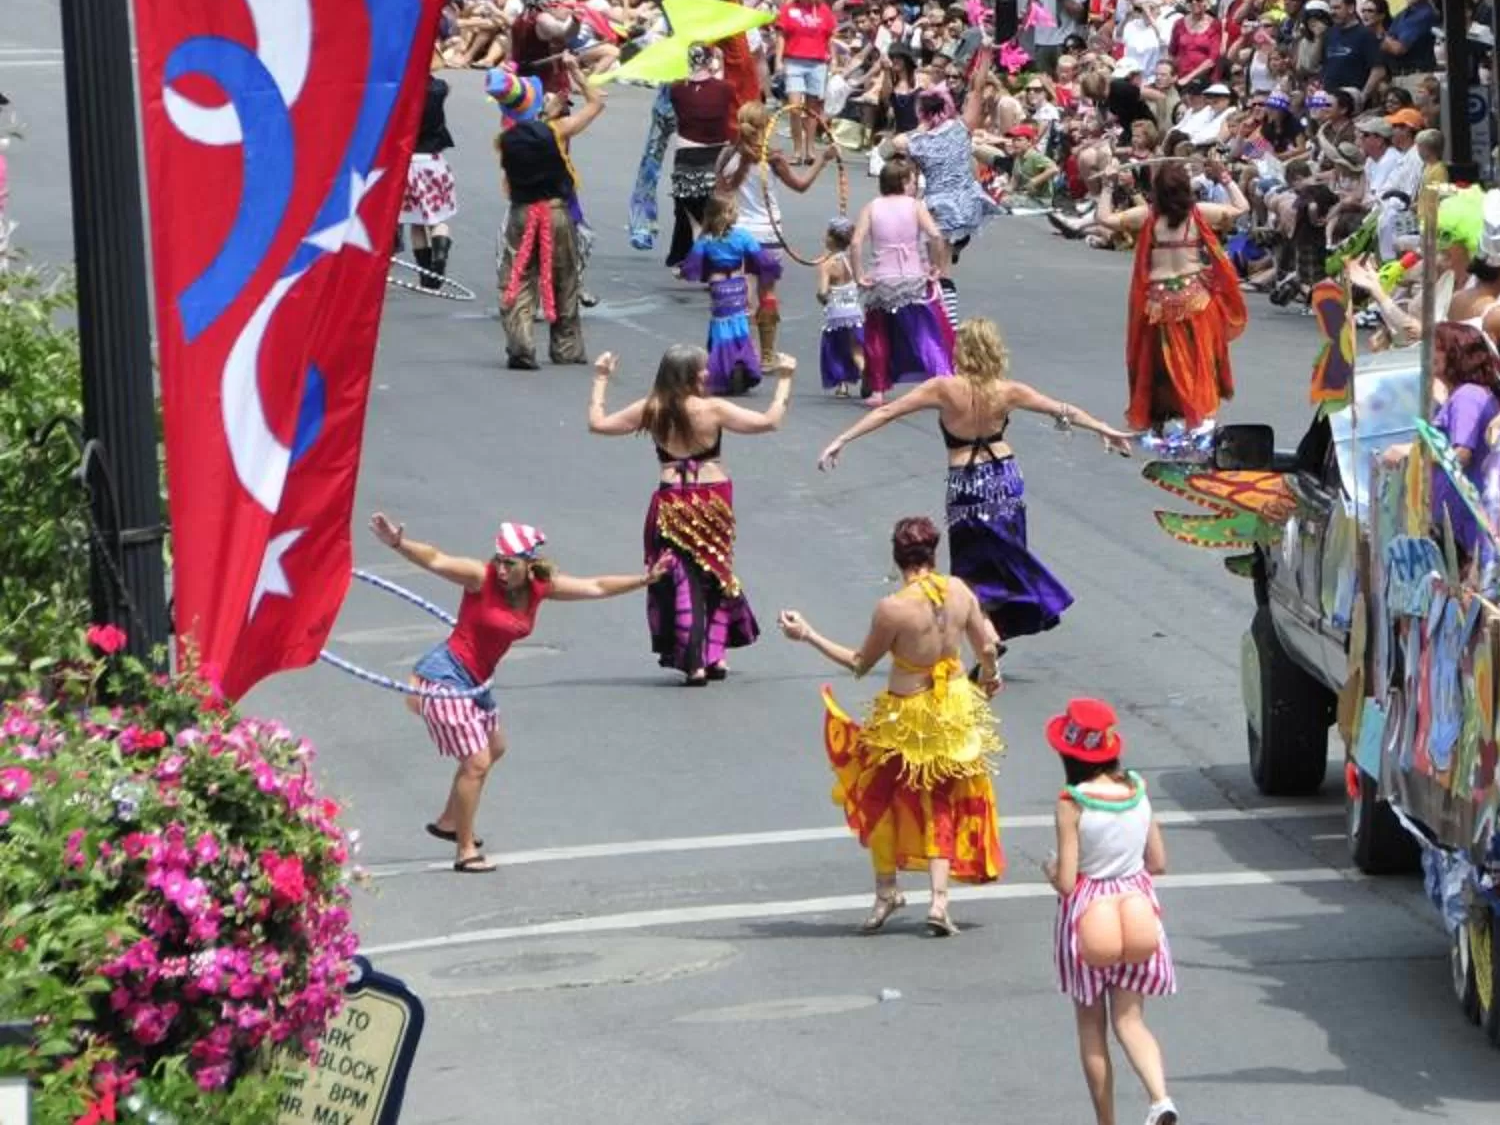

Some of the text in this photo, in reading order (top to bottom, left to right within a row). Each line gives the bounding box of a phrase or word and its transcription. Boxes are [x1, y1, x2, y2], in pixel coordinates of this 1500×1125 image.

[347, 1007, 370, 1031] TO
[318, 1048, 379, 1084] BLOCK
[329, 1082, 369, 1110] 8PM
